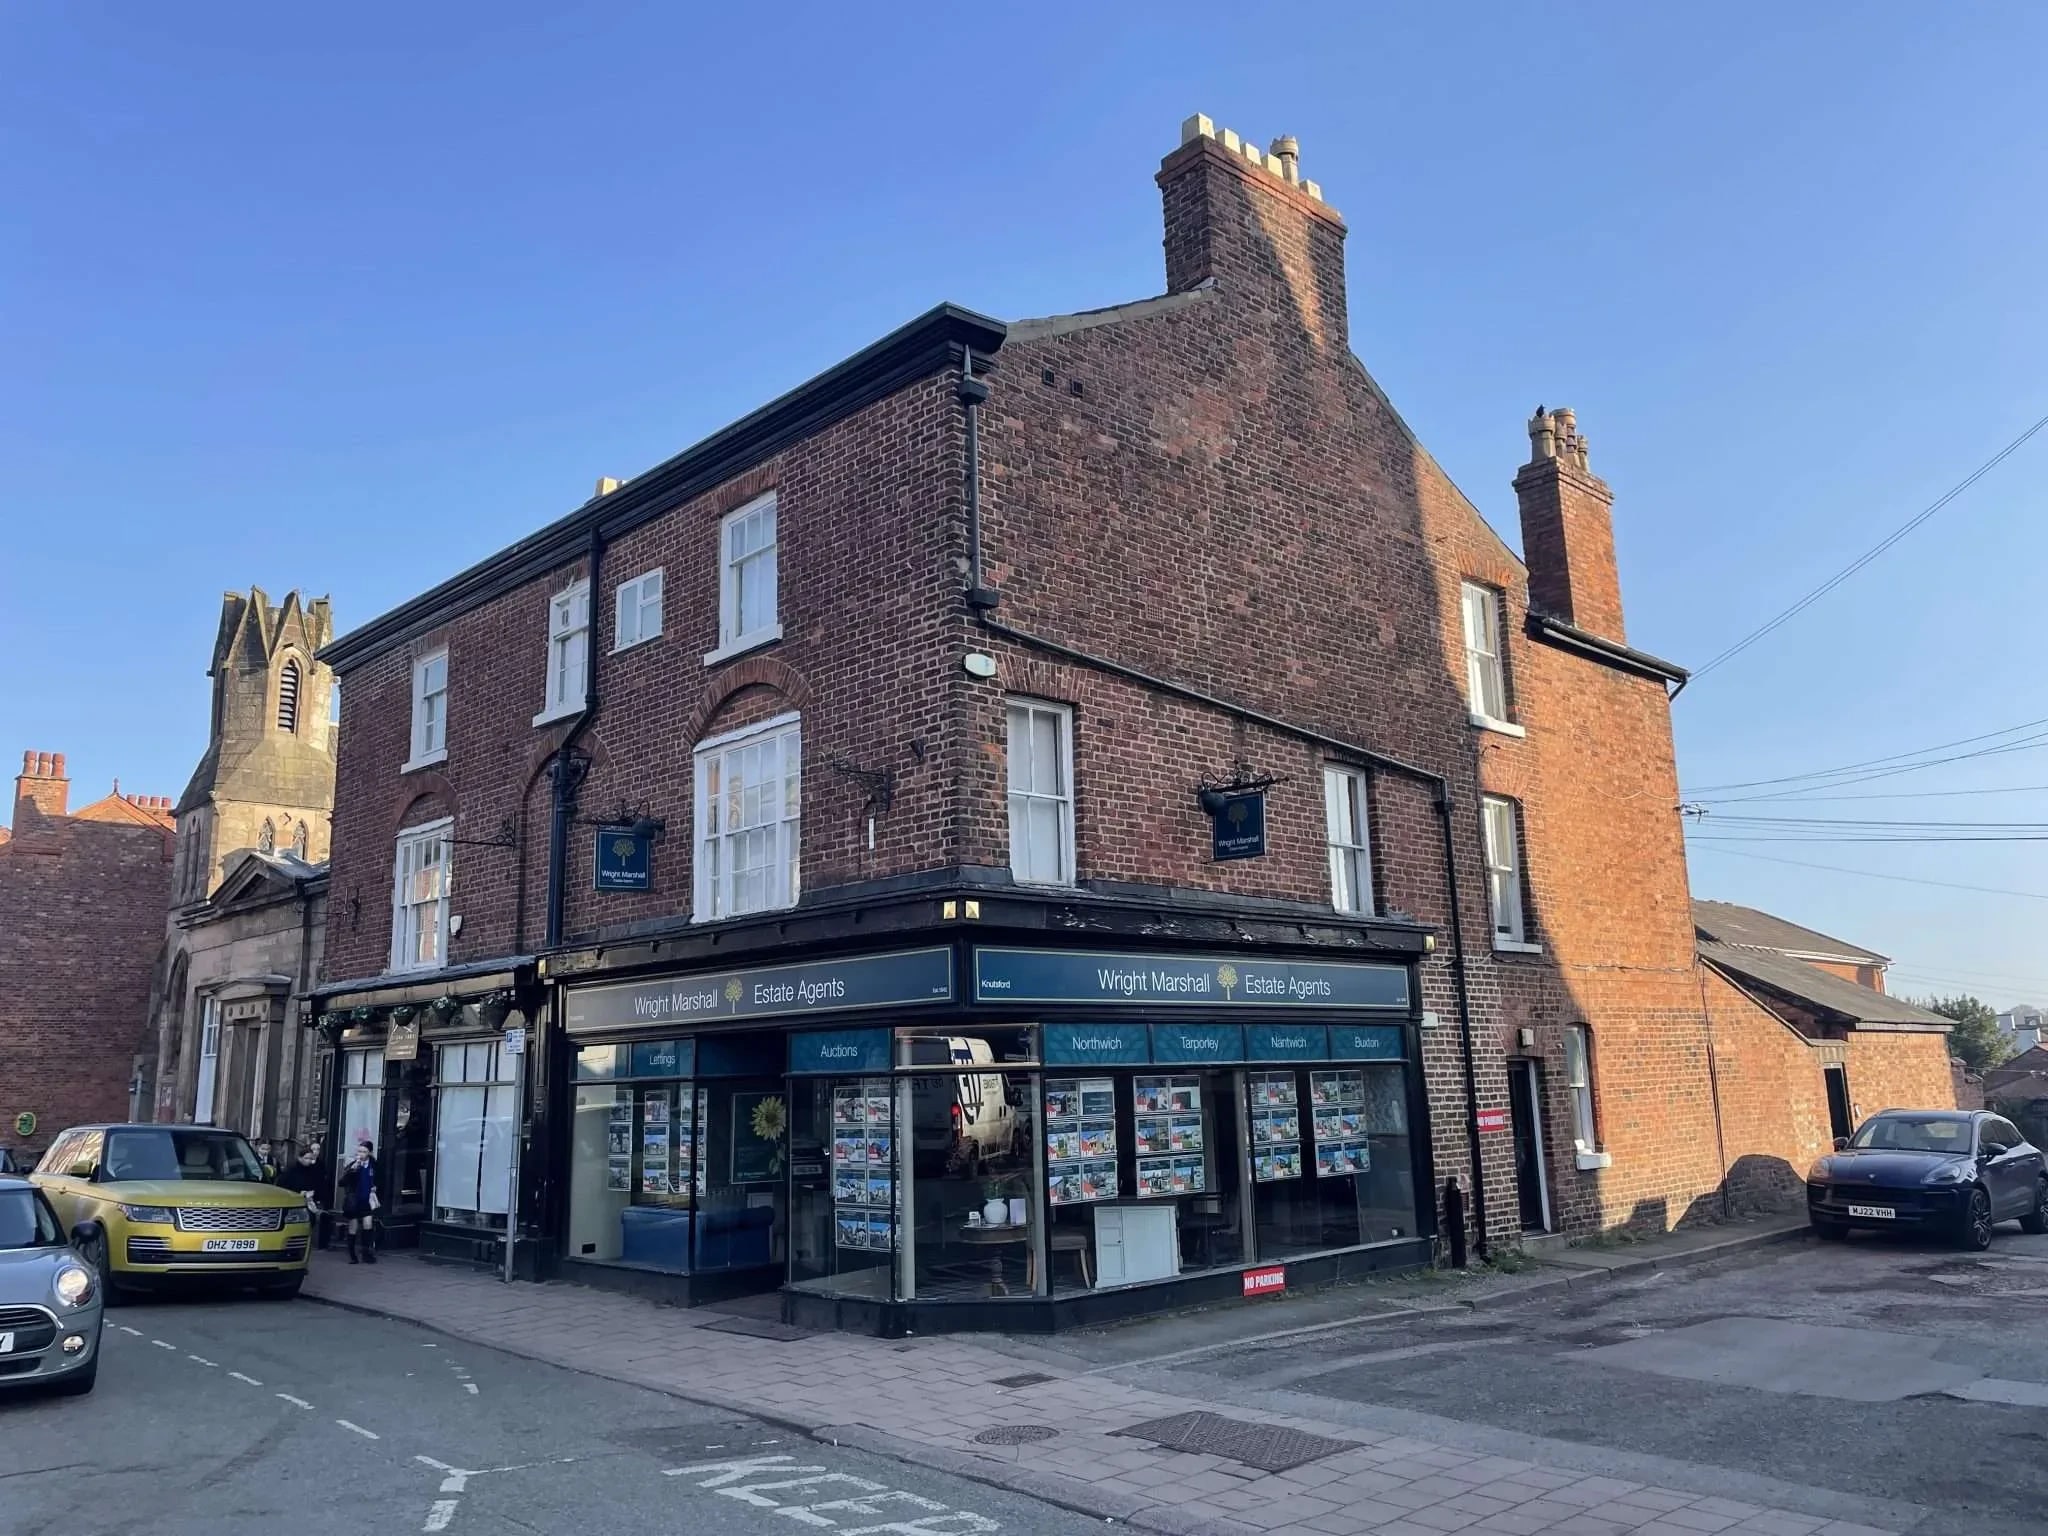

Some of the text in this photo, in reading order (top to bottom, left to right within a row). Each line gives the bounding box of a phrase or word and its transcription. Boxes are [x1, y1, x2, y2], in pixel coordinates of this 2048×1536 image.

[601, 870, 646, 879] Wright Marshall
[981, 979, 1011, 989] Knutsford
[1097, 968, 1331, 1000] Wright Marshall Estate Agents
[634, 977, 845, 1018] Wright Marshall Estate Agents
[1072, 1036, 1122, 1050] Northwich
[1180, 1036, 1219, 1052] Tarporley
[1271, 1036, 1307, 1049] Nantwich
[1354, 1036, 1379, 1048] Buxton
[820, 1044, 858, 1058] Auctions
[649, 1053, 676, 1068] Lettings
[207, 1240, 256, 1250] OHZ 7898
[1244, 1272, 1284, 1290] NO PARKING
